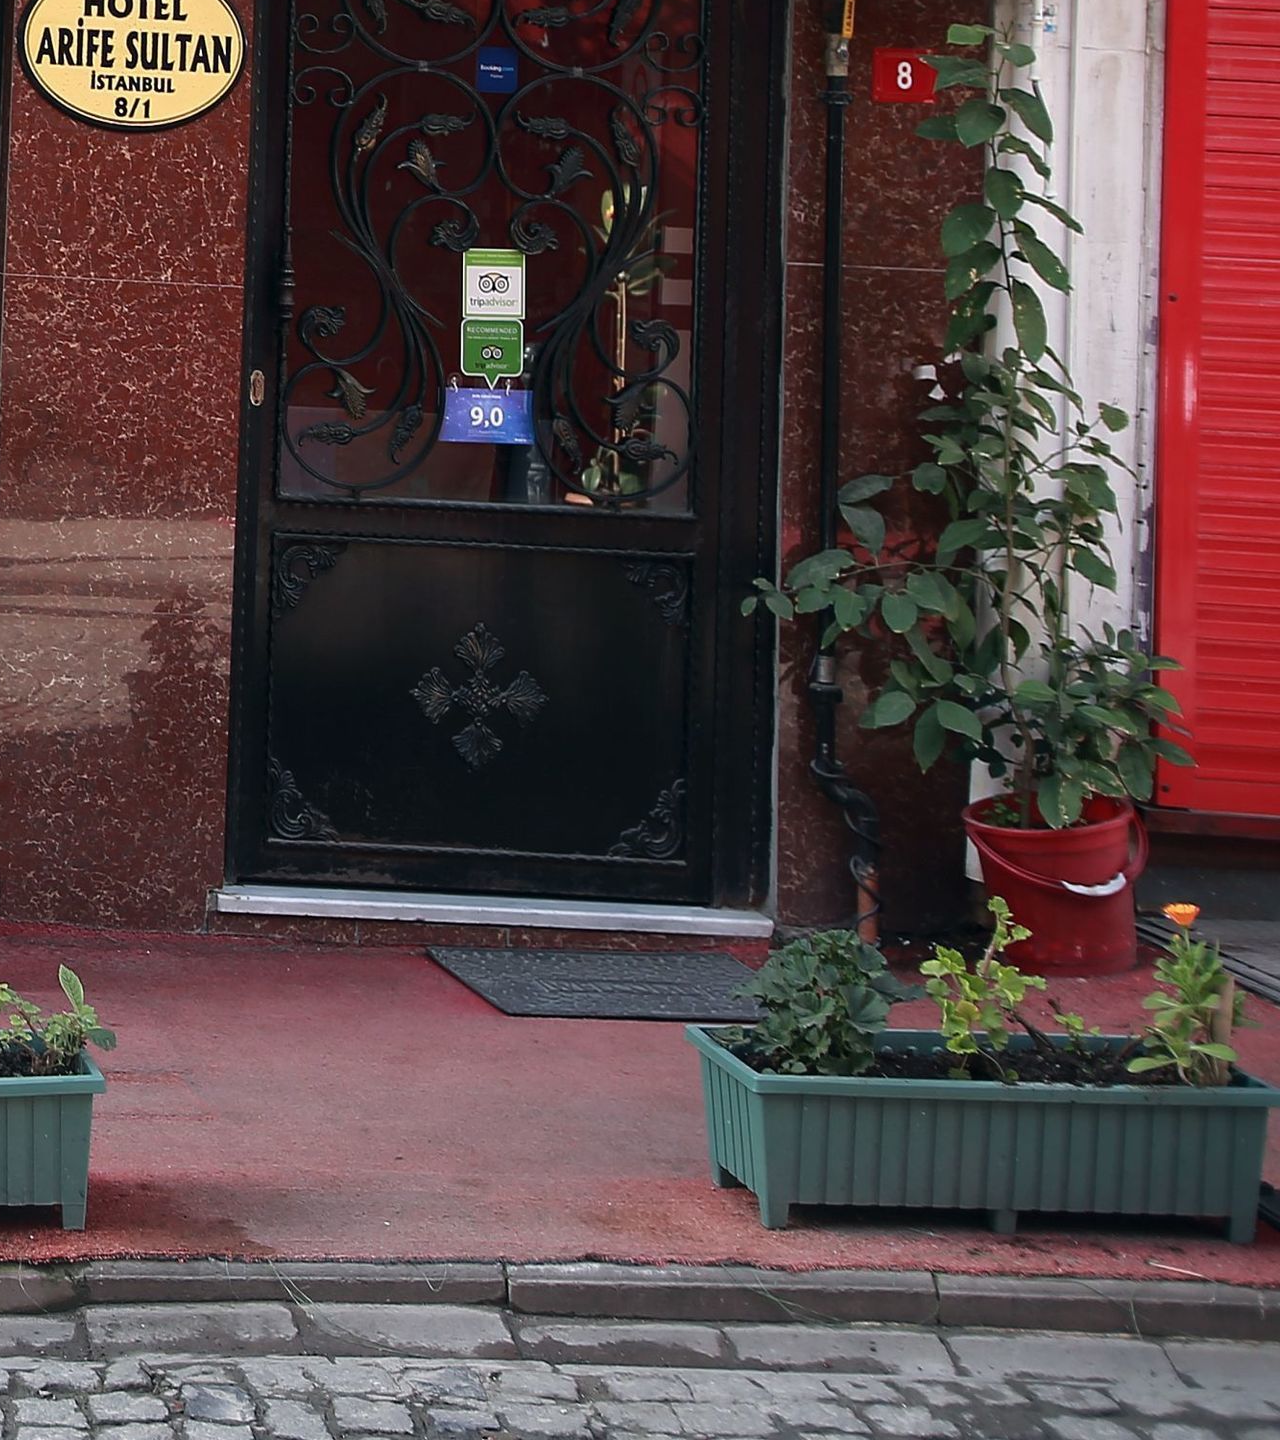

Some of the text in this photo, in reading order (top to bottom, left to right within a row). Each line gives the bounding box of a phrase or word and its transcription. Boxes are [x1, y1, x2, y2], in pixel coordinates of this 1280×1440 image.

[35, 18, 233, 74] ARİFE SULTAN
[90, 71, 176, 93] İSTANBUL
[896, 61, 913, 90] 8
[113, 97, 152, 119] 8/1
[470, 295, 516, 308] tripadvisor
[466, 326, 518, 334] RECOMMENDED
[470, 405, 504, 428] 9,0
